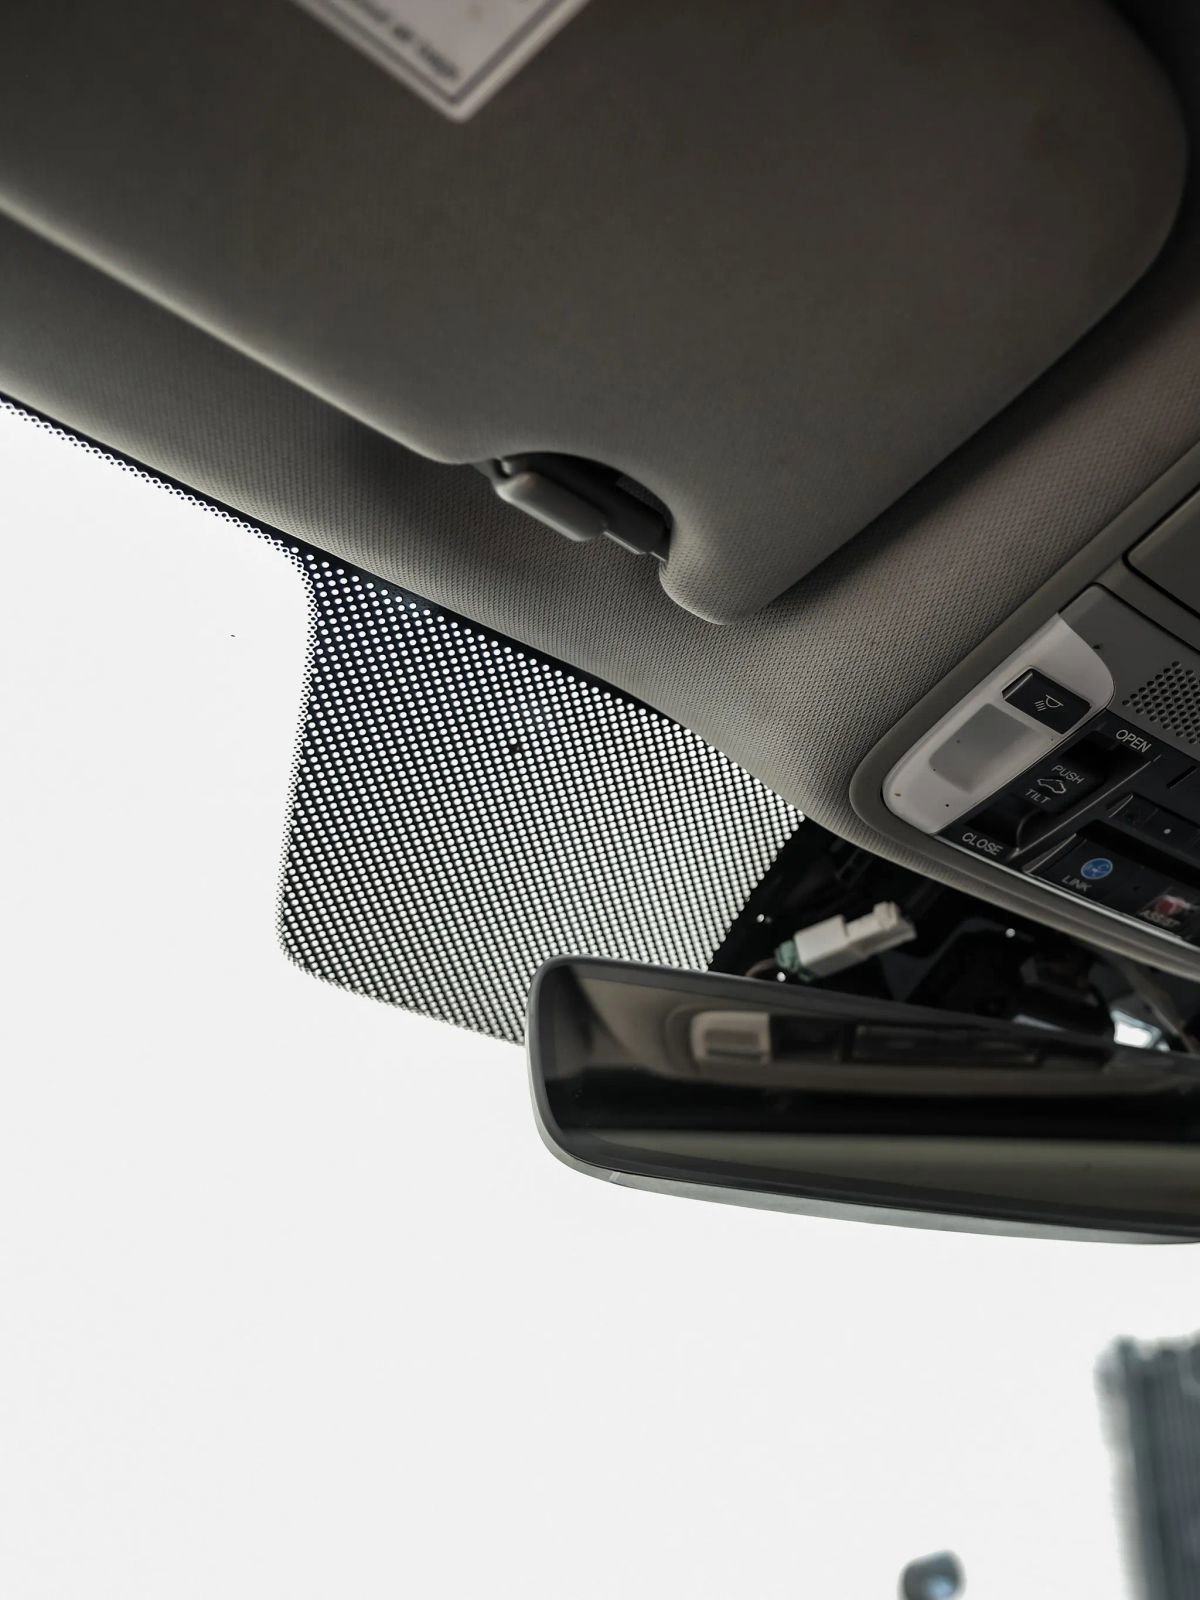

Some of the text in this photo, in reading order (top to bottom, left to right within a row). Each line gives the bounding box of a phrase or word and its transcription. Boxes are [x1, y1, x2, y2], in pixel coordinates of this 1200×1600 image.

[1115, 729, 1152, 753] OPEN
[1051, 764, 1085, 784] PUSH
[1024, 788, 1052, 804] TILT
[961, 832, 1003, 856] CLOSE
[1061, 875, 1092, 892] LINK
